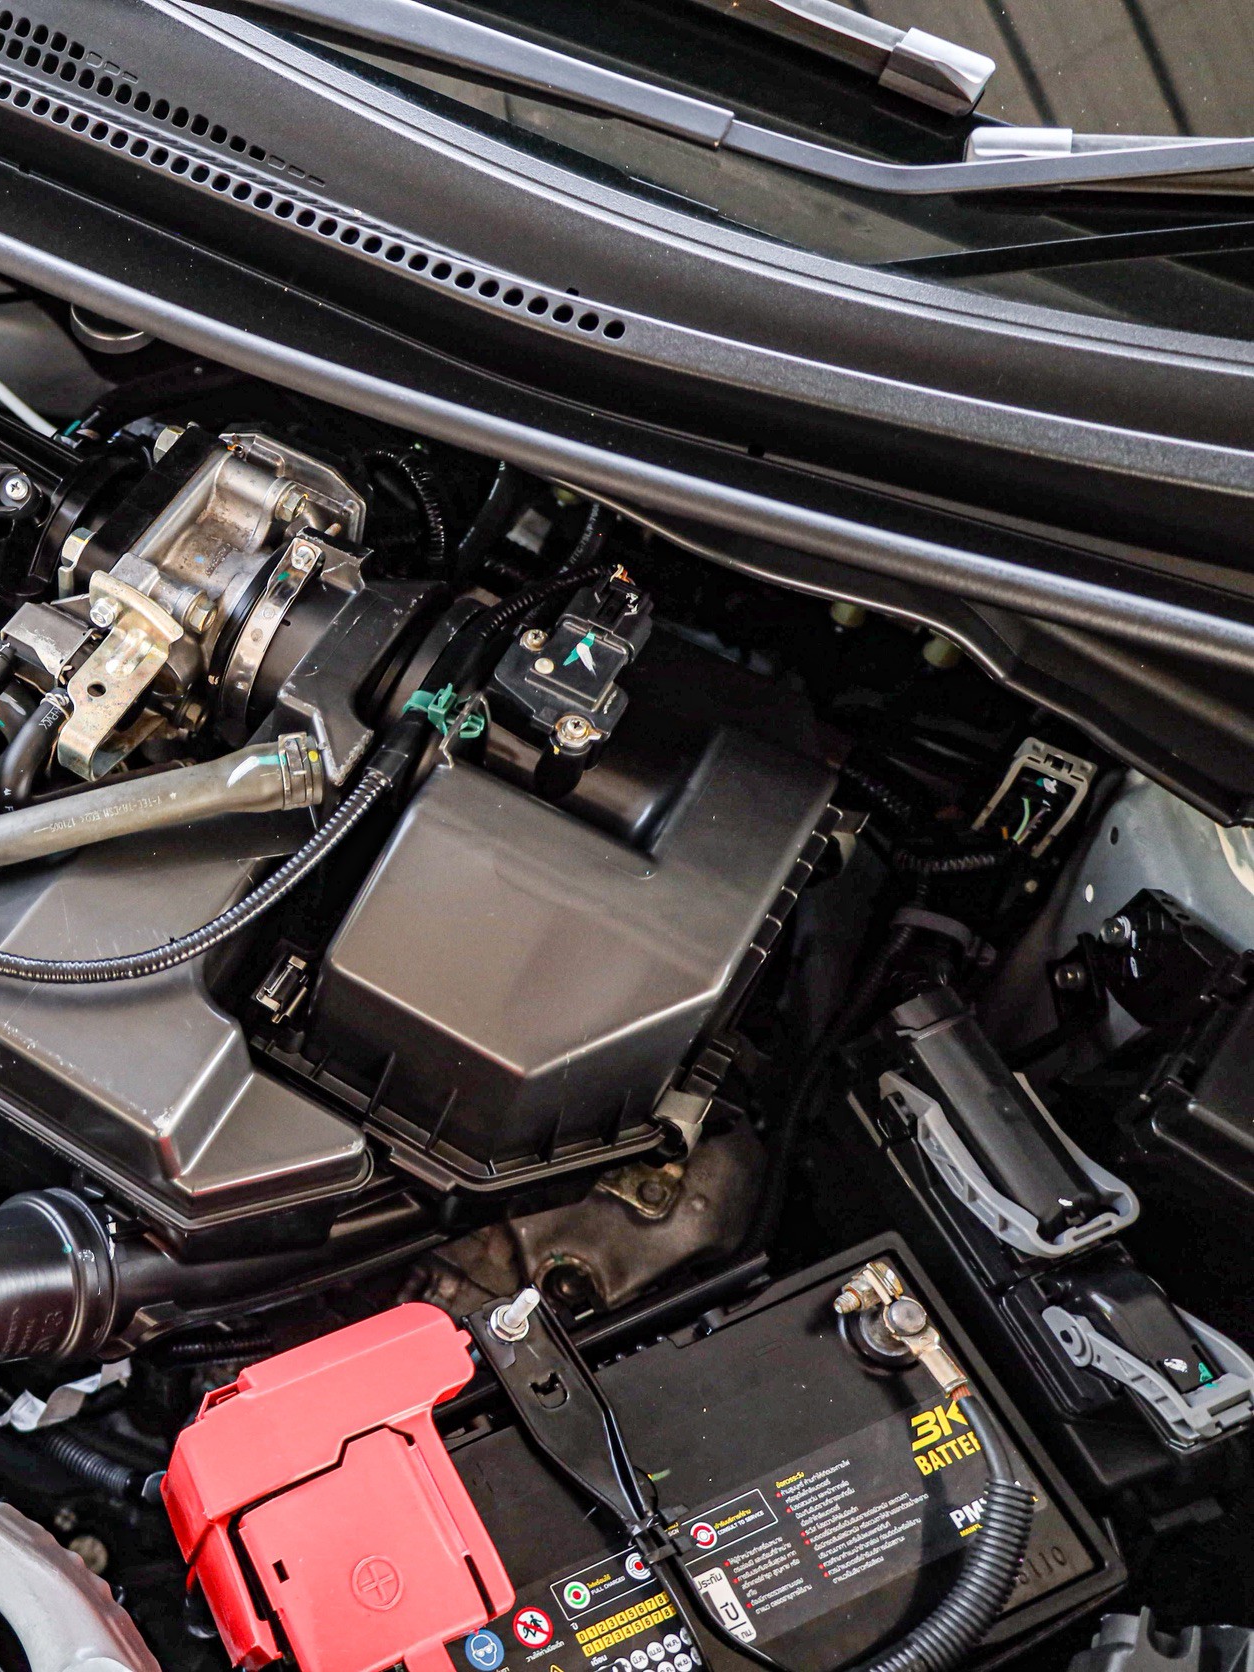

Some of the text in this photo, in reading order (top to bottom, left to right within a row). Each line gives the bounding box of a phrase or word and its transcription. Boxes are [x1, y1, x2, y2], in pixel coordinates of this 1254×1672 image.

[717, 1522, 738, 1535] CONSULT
[745, 1510, 764, 1522] SERVICE
[590, 1576, 625, 1595] FULL CHARGED
[718, 1599, 740, 1623] ปี
[590, 1654, 608, 1667] เดือน
